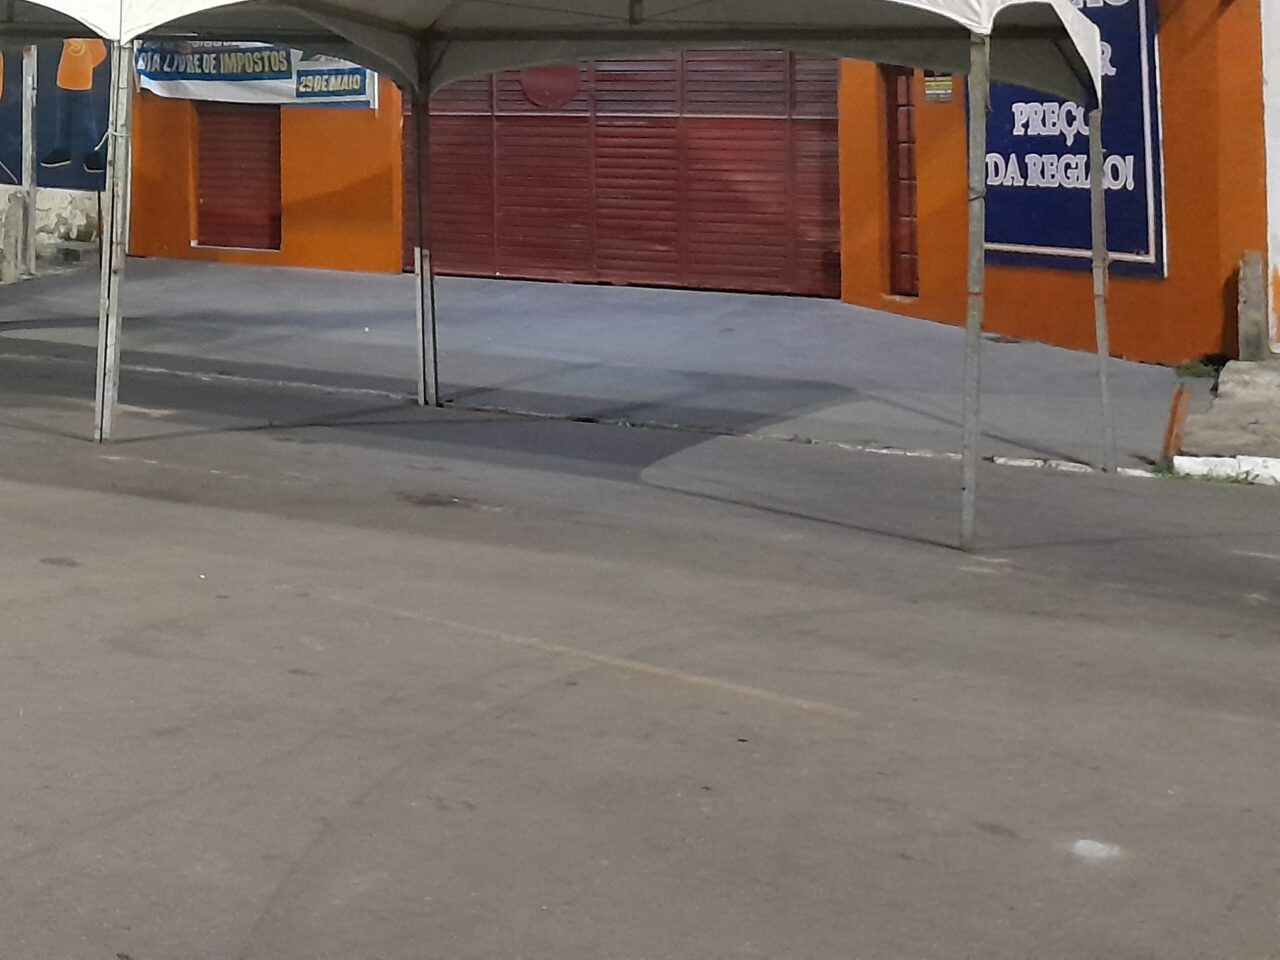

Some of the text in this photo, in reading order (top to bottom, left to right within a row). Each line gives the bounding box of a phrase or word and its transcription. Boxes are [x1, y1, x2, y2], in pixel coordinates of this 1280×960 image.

[220, 50, 288, 74] IMPOSTOS
[313, 74, 328, 92] DE
[328, 73, 361, 91] MAIO
[985, 153, 1134, 190] DA REGIO!
